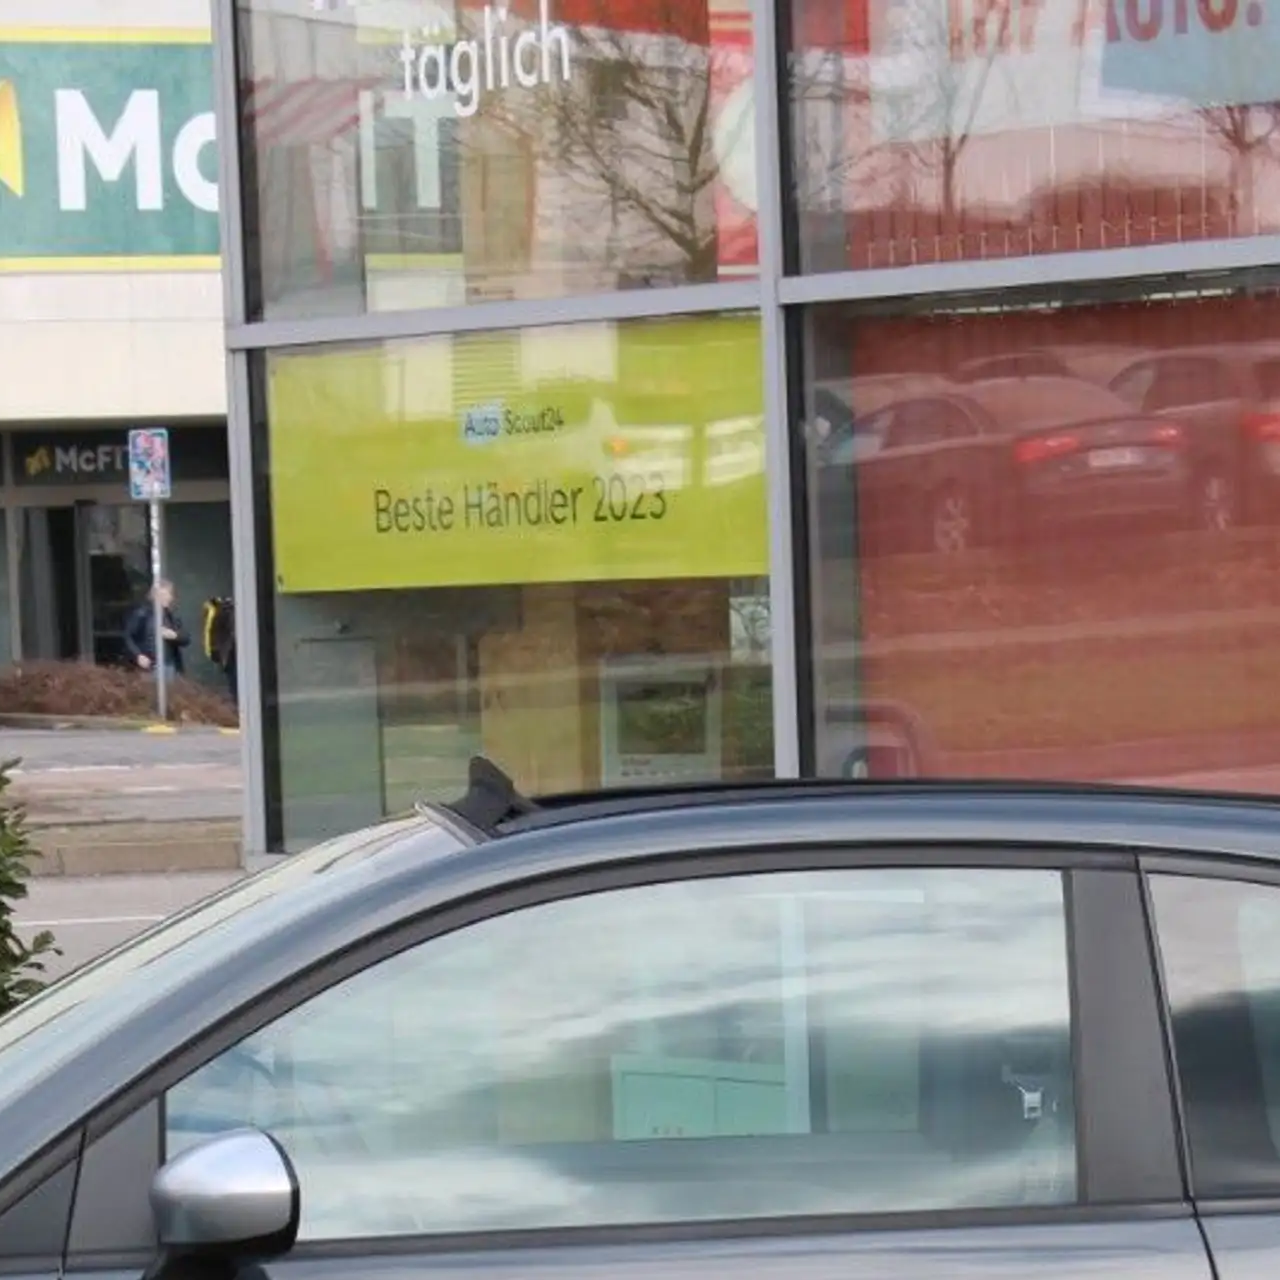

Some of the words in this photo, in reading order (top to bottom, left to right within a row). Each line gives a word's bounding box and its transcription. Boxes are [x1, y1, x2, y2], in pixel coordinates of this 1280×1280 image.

[400, 0, 570, 117] täglich
[54, 443, 129, 472] McFI
[374, 487, 454, 533] Beste
[463, 479, 583, 529] Händler
[591, 473, 667, 522] 2023
